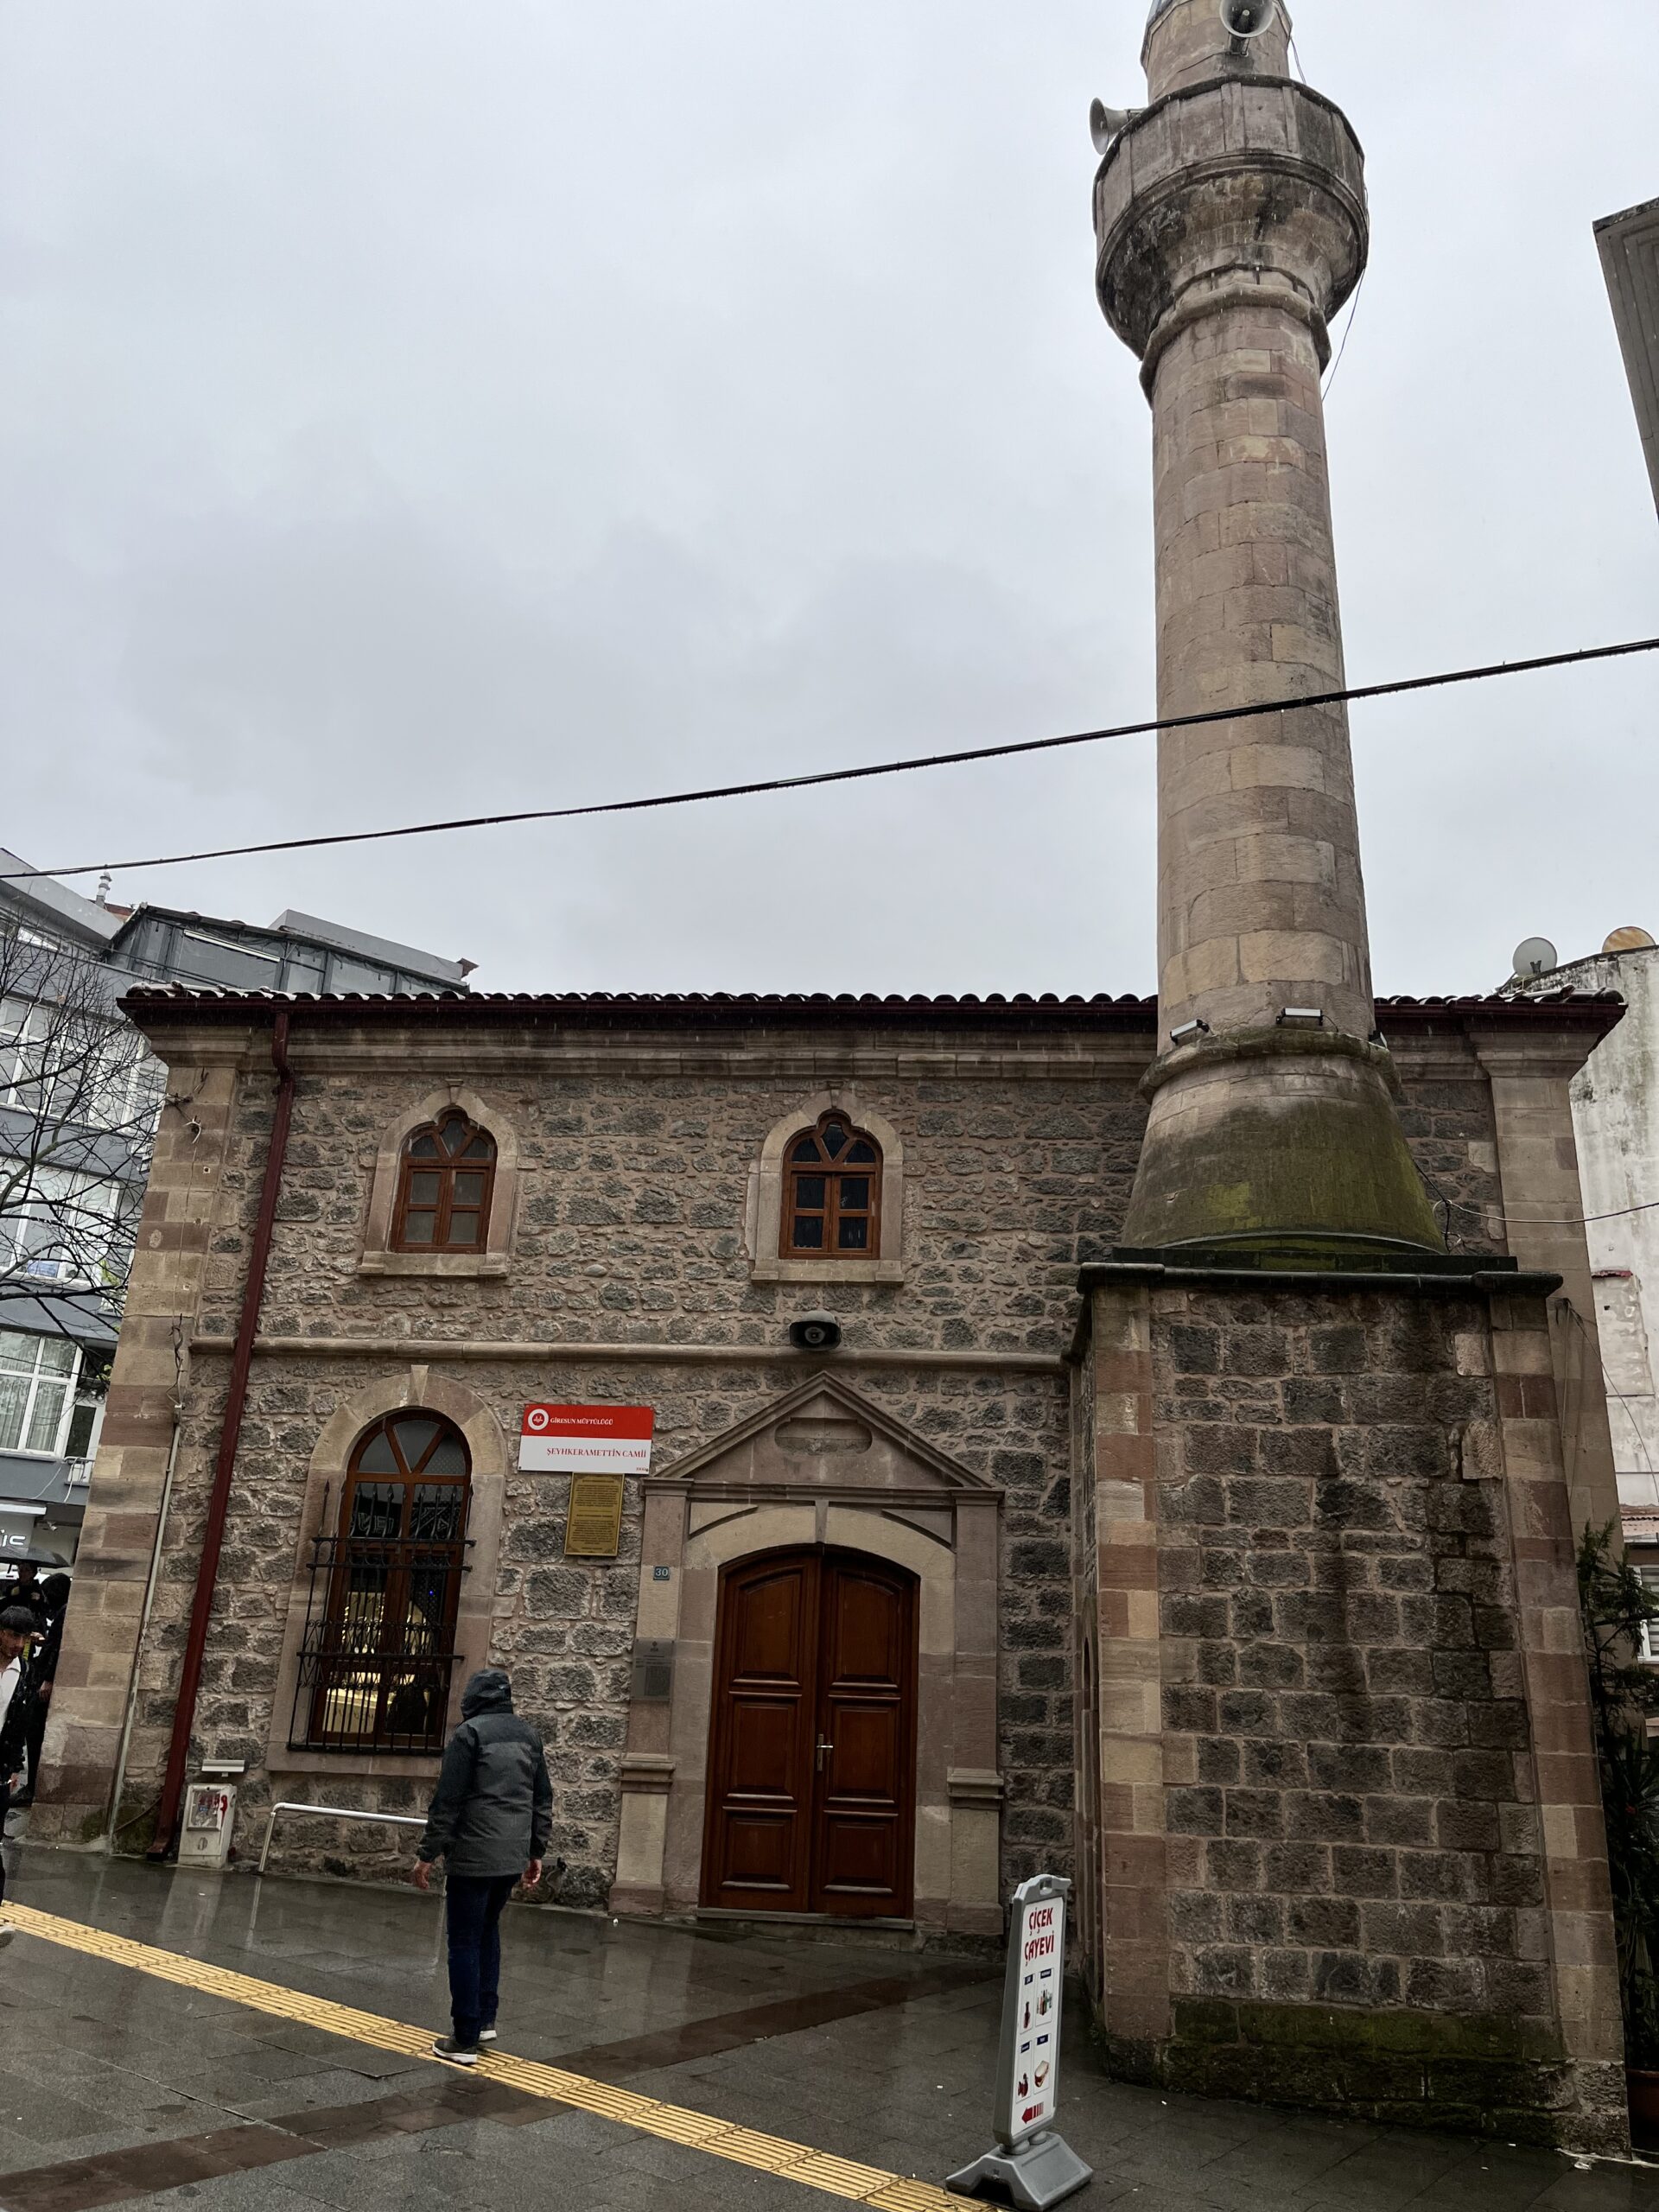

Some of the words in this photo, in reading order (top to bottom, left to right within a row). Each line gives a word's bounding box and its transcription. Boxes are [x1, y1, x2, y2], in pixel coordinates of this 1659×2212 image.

[547, 1448, 620, 1457] ŞEYHKERAMETTİN
[622, 1449, 646, 1458] CAMİİ
[655, 1568, 668, 1577] 30
[1028, 1907, 1053, 1936] ÇİÇEK
[1024, 1930, 1055, 1966] ÇAYEVİ
